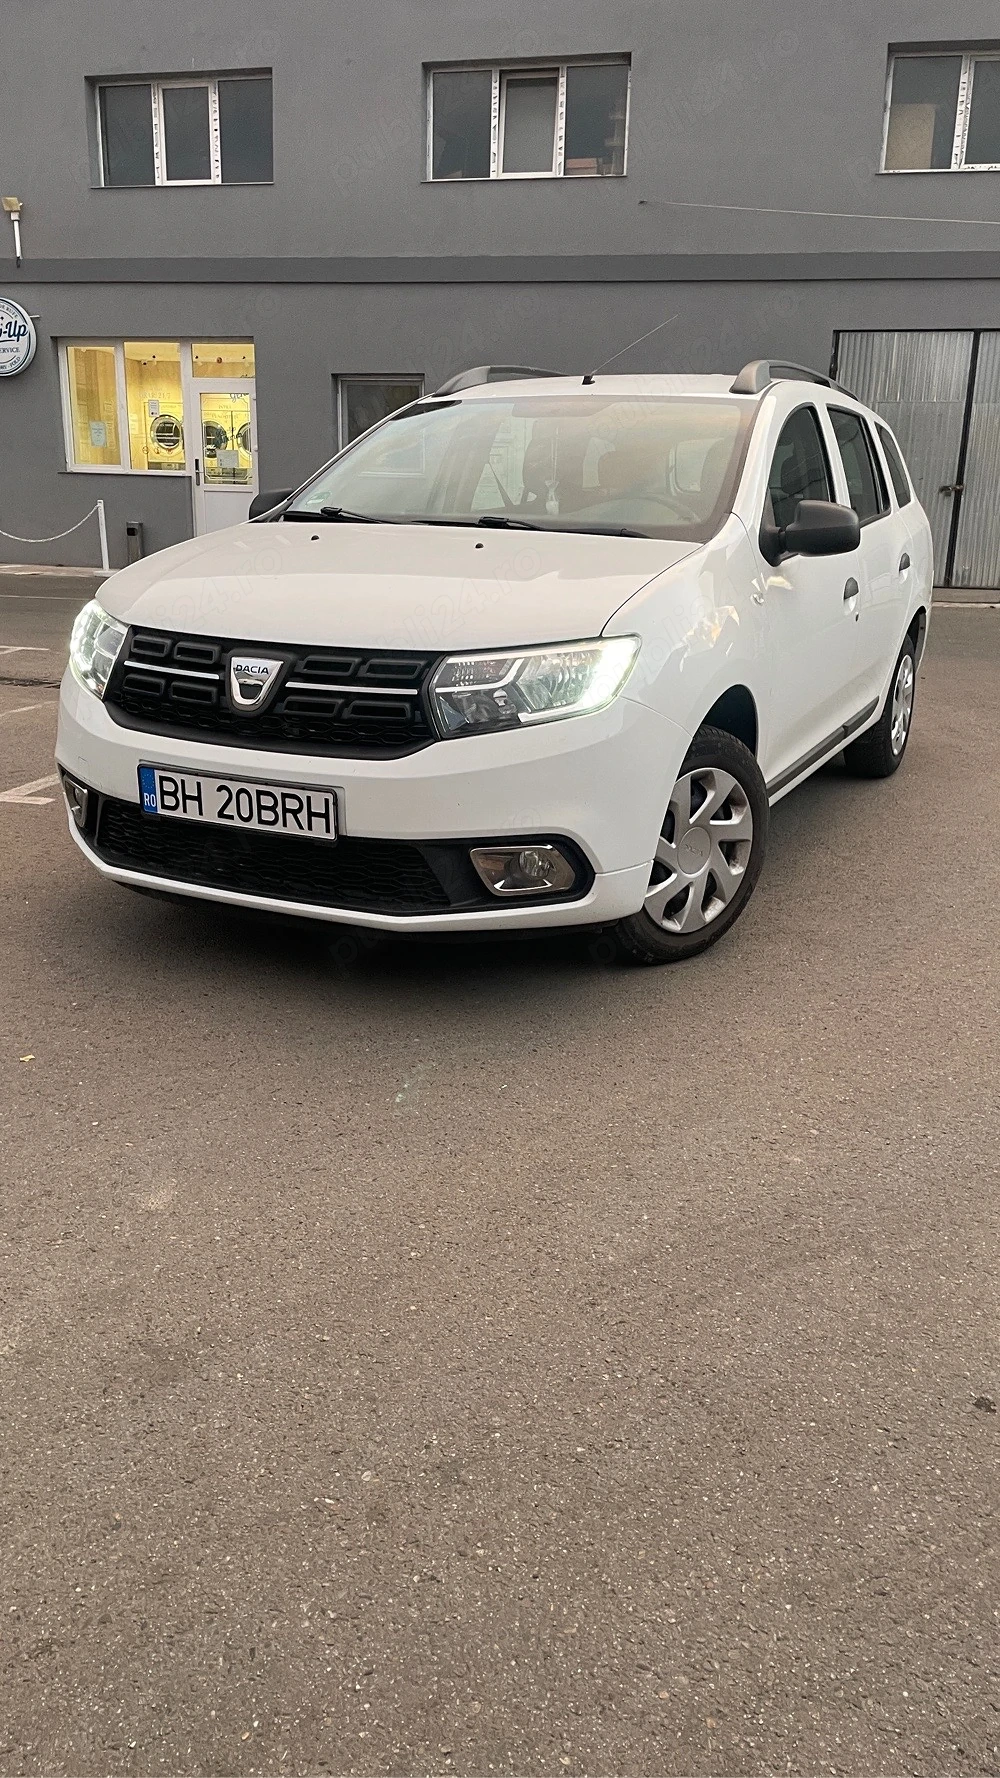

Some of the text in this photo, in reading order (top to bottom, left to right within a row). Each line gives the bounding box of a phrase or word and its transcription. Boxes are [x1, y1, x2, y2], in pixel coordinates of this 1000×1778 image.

[233, 663, 270, 675] DACIA
[143, 791, 156, 808] RO
[158, 774, 331, 834] BH 20BRH
